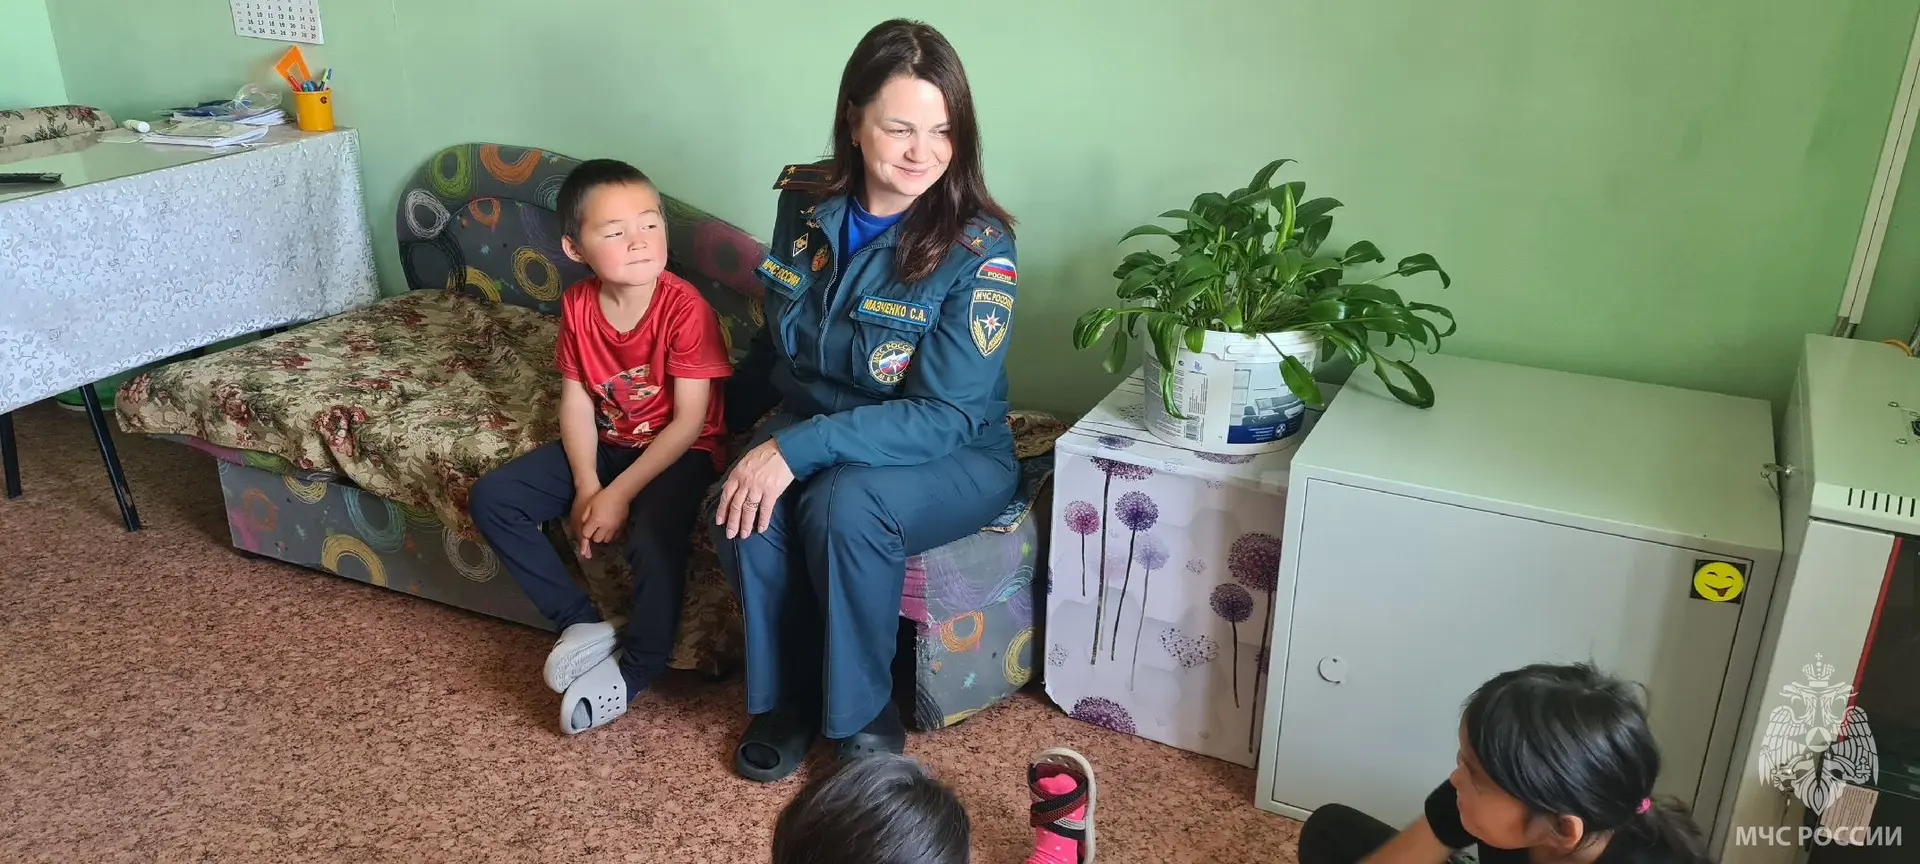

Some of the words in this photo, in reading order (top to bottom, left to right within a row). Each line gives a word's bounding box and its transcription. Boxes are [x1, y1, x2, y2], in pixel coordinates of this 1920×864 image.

[761, 258, 780, 275] МЧС
[775, 267, 801, 287] РОССИИ
[975, 291, 992, 301] МЧС
[862, 299, 907, 317] МАЗЧЕНКО
[910, 308, 927, 322] С.А.
[872, 347, 887, 364] МЧС
